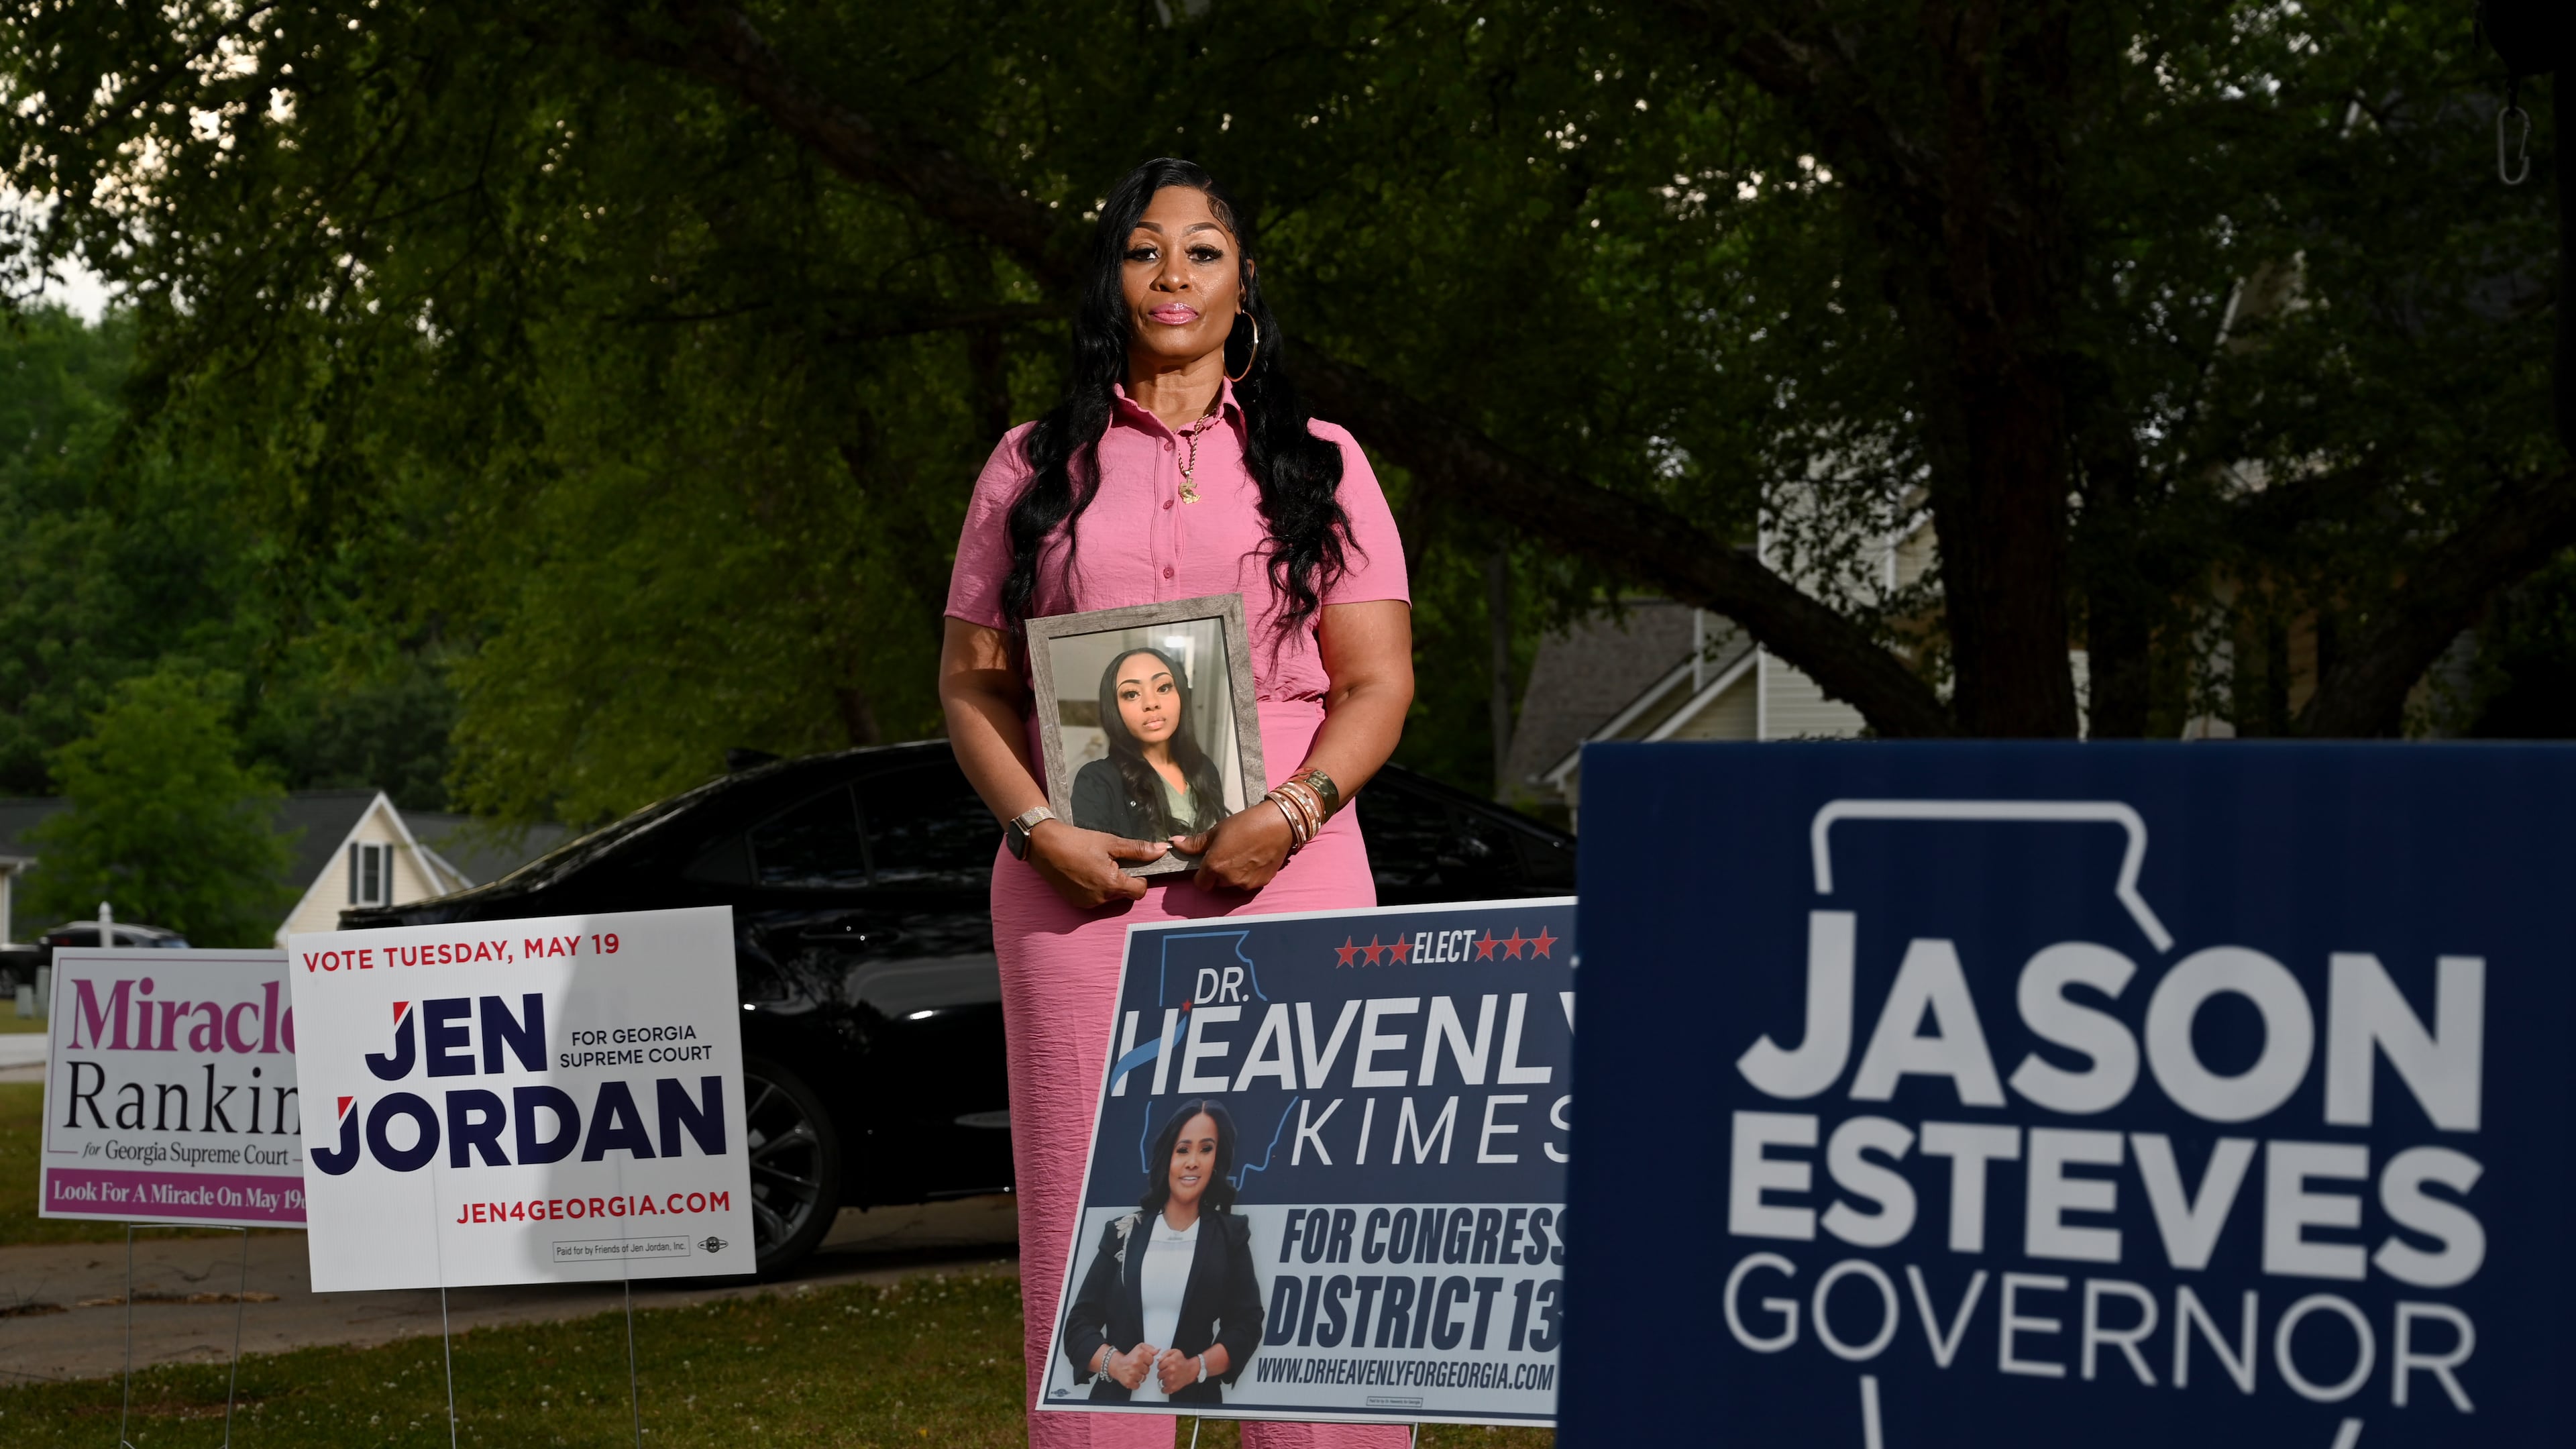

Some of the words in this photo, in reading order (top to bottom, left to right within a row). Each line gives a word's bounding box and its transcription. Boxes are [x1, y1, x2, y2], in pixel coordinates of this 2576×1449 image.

[303, 949, 374, 972] VOTE
[383, 941, 513, 967] TUESDAY,
[525, 935, 581, 959] MAY
[592, 933, 620, 955] 19
[1411, 929, 1477, 964] ELECT
[1194, 967, 1251, 1006] DR.
[365, 993, 548, 1081] JEN
[572, 1030, 608, 1046] FOR
[612, 1024, 697, 1044] GEORGIA
[1735, 910, 2485, 1132] JASON
[559, 1049, 644, 1068] SUPREME
[648, 1044, 712, 1063] COURT
[311, 1075, 727, 1176] JORDAN
[82, 1142, 101, 1159] for
[105, 1139, 167, 1166] Georgia
[170, 1142, 241, 1168] Supreme
[244, 1144, 289, 1166] Court
[53, 1180, 98, 1201] Look
[101, 1182, 130, 1203] For
[133, 1183, 147, 1203] A
[150, 1183, 215, 1206] Miracle
[217, 1186, 242, 1208] On
[246, 1187, 280, 1213] May
[457, 1191, 731, 1224] JEN4GEORGIA.COM
[1727, 1109, 2486, 1289] ESTEVES
[557, 1246, 572, 1256] Paid
[574, 1246, 583, 1254] for
[584, 1246, 593, 1256] by
[595, 1244, 620, 1254] Friends
[621, 1243, 629, 1253] of
[631, 1243, 644, 1253] Jen
[645, 1242, 672, 1252] Jordan,
[674, 1241, 687, 1251] Inc.
[1279, 1208, 1358, 1265] FOR
[1263, 1275, 1502, 1351] DISTRICT
[1507, 1277, 1563, 1353] 13
[1723, 1252, 2477, 1413] GOVERNOR
[1256, 1356, 1555, 1391] WWW.DRHEAVENLYFORGEORGIA.COM
